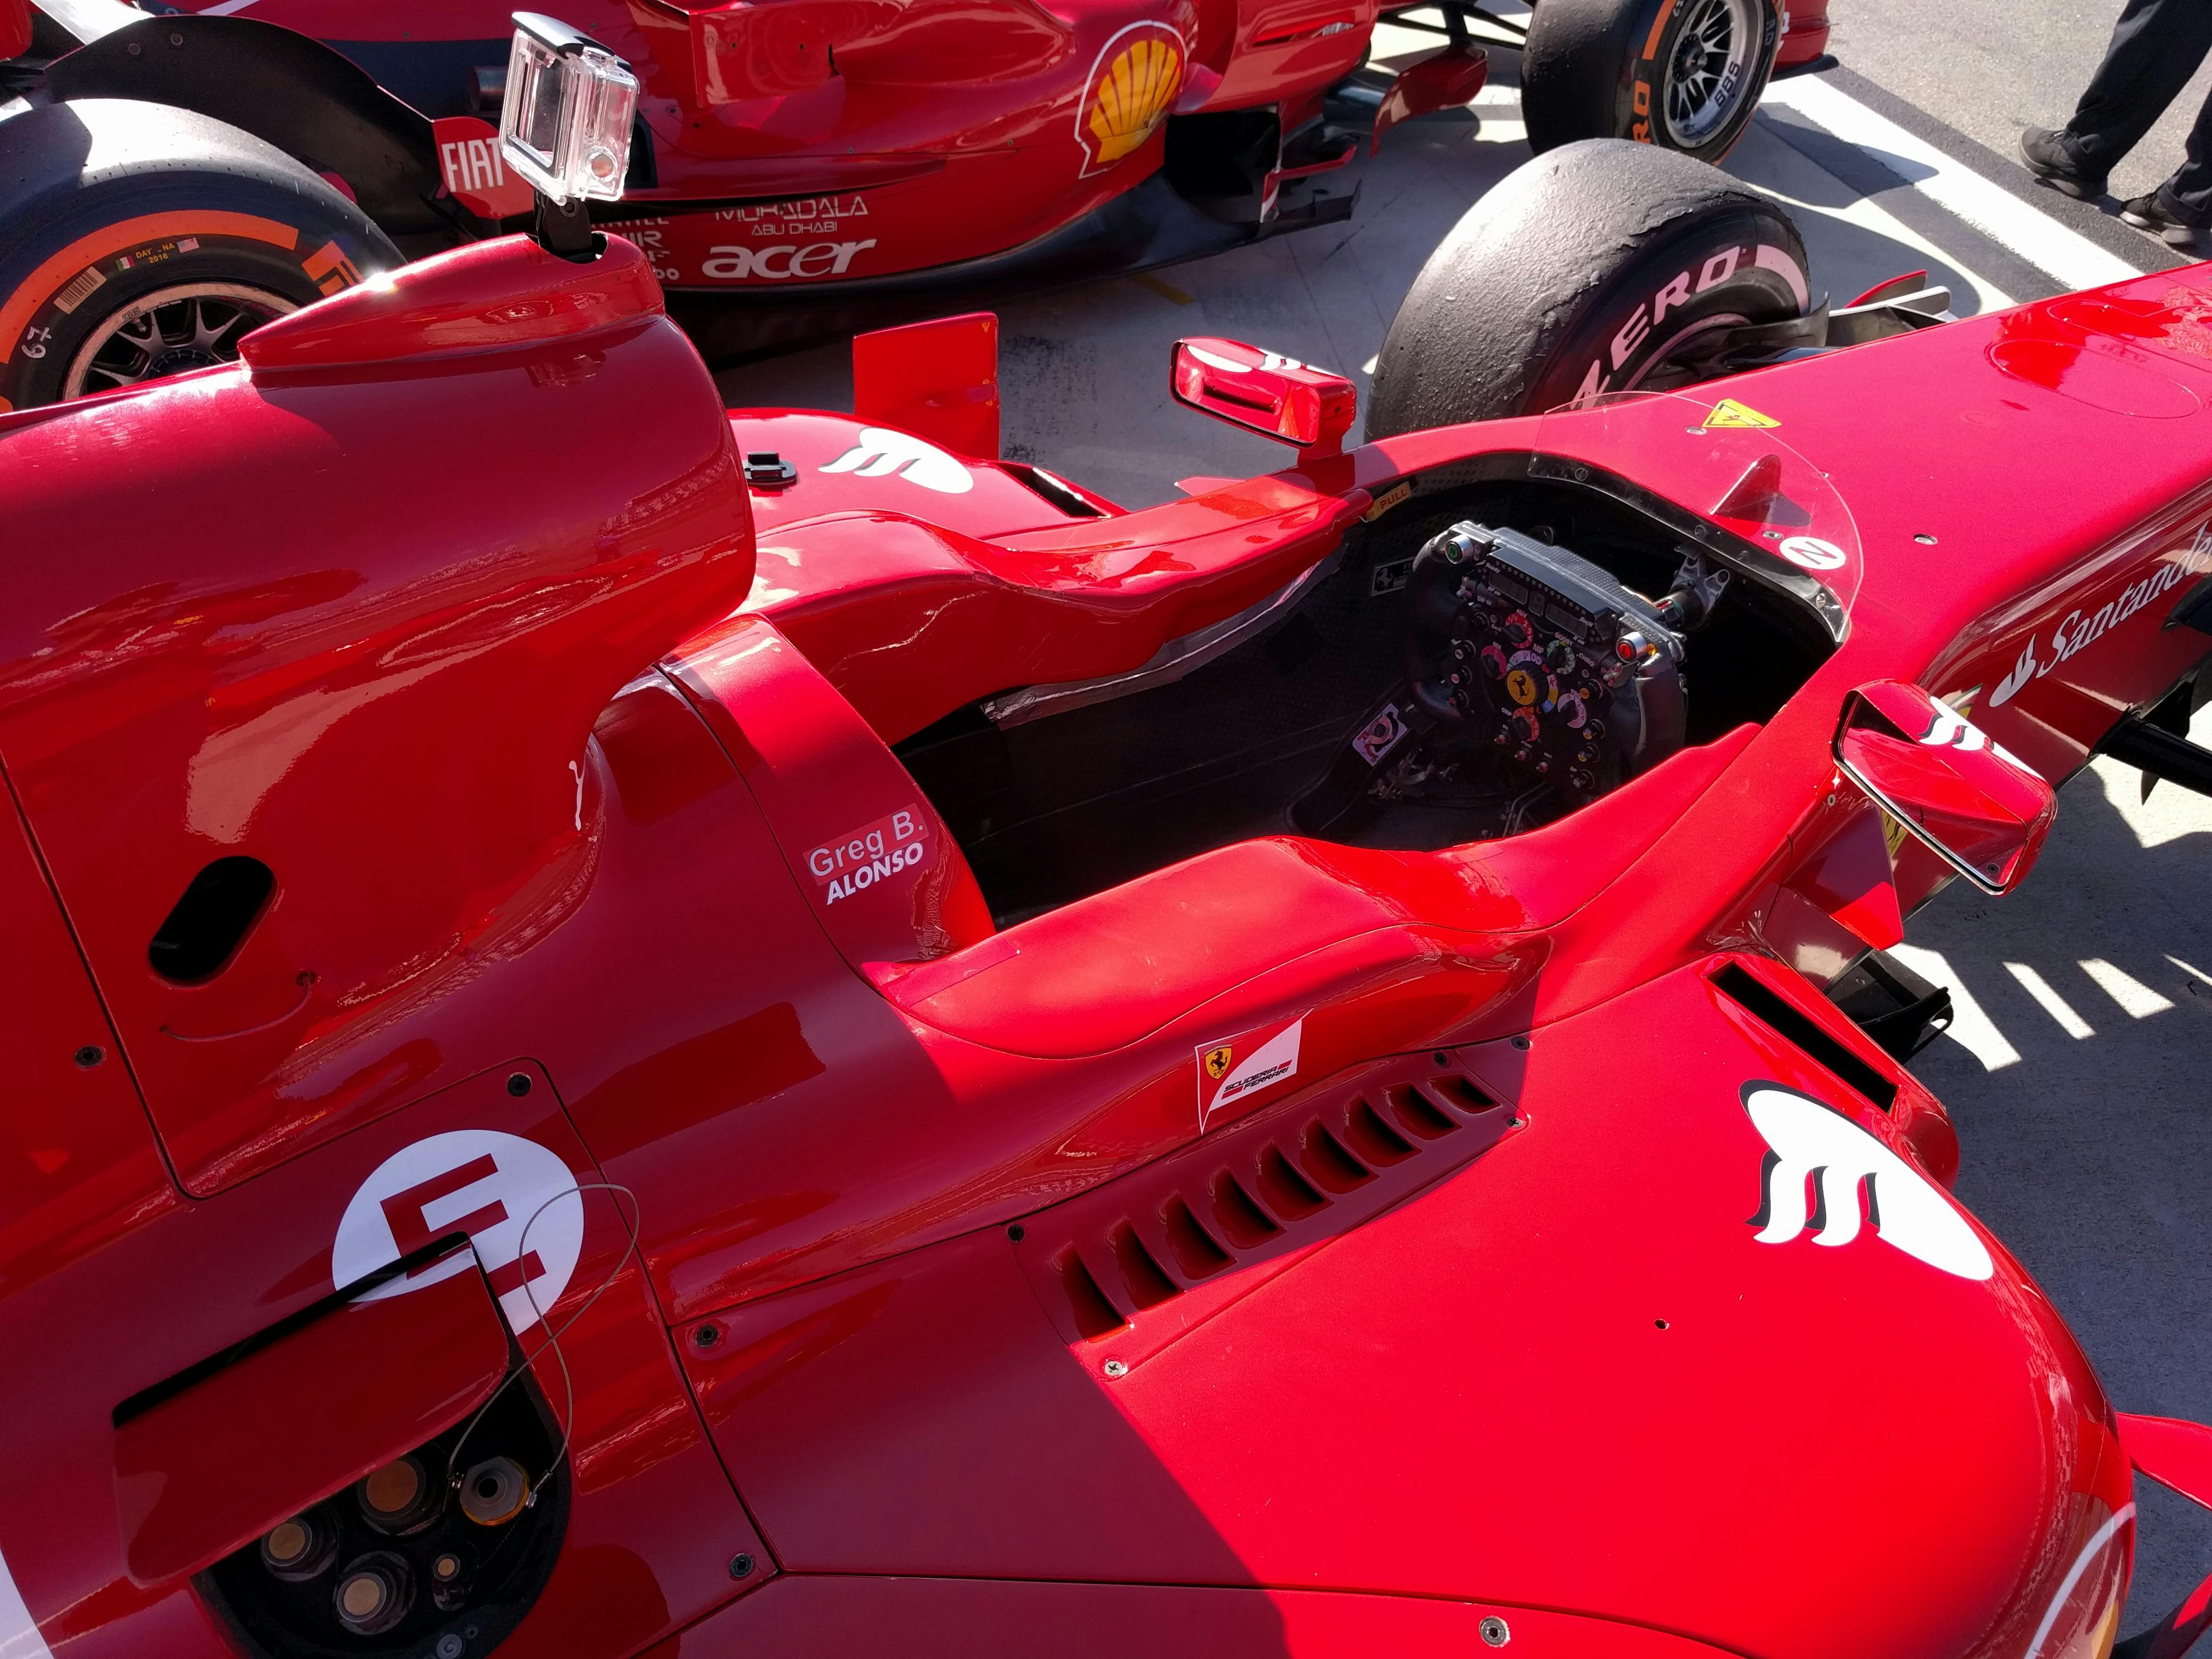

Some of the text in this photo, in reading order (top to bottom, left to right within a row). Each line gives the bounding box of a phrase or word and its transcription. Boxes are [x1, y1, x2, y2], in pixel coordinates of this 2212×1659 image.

[1714, 61, 1740, 108] BBS
[441, 137, 504, 193] FIAT
[752, 221, 838, 236] ABU DHABI
[136, 242, 175, 259] DAYNA
[702, 238, 878, 279] acer
[1570, 245, 1740, 409] ZERO
[1379, 489, 1409, 510] PULL
[810, 811, 923, 876] Greg B.
[827, 842, 924, 906] ALONSO
[1224, 1066, 1278, 1092] SCUDERIA
[1243, 1066, 1289, 1091] FERRARI
